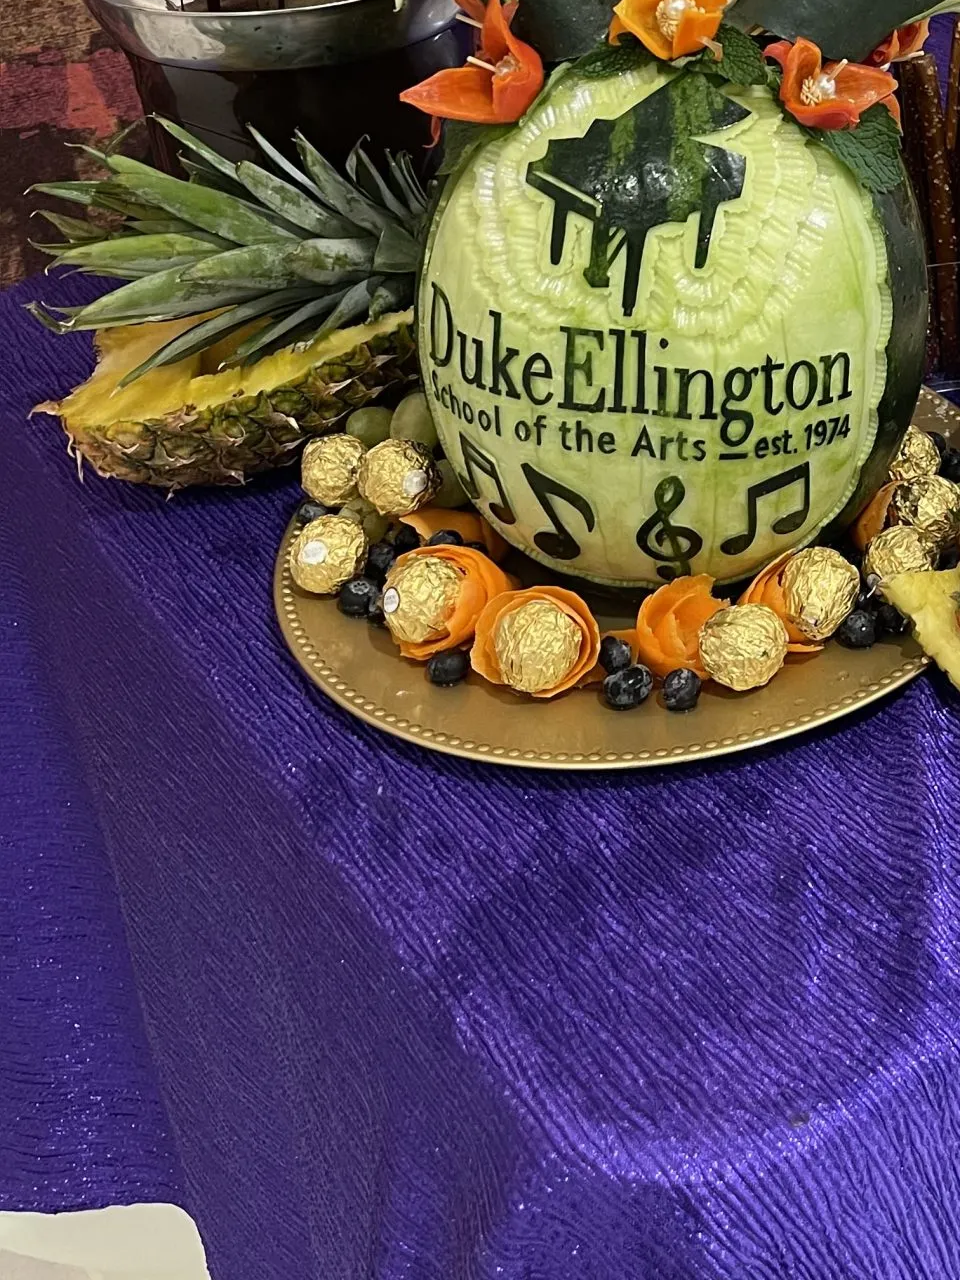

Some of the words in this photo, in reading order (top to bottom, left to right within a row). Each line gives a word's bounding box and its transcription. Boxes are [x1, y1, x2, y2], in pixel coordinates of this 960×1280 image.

[431, 369, 502, 437] School
[514, 414, 548, 447] of
[559, 421, 616, 454] the
[631, 425, 707, 462] Arts
[753, 428, 799, 459] est.
[803, 413, 852, 452] 1974
